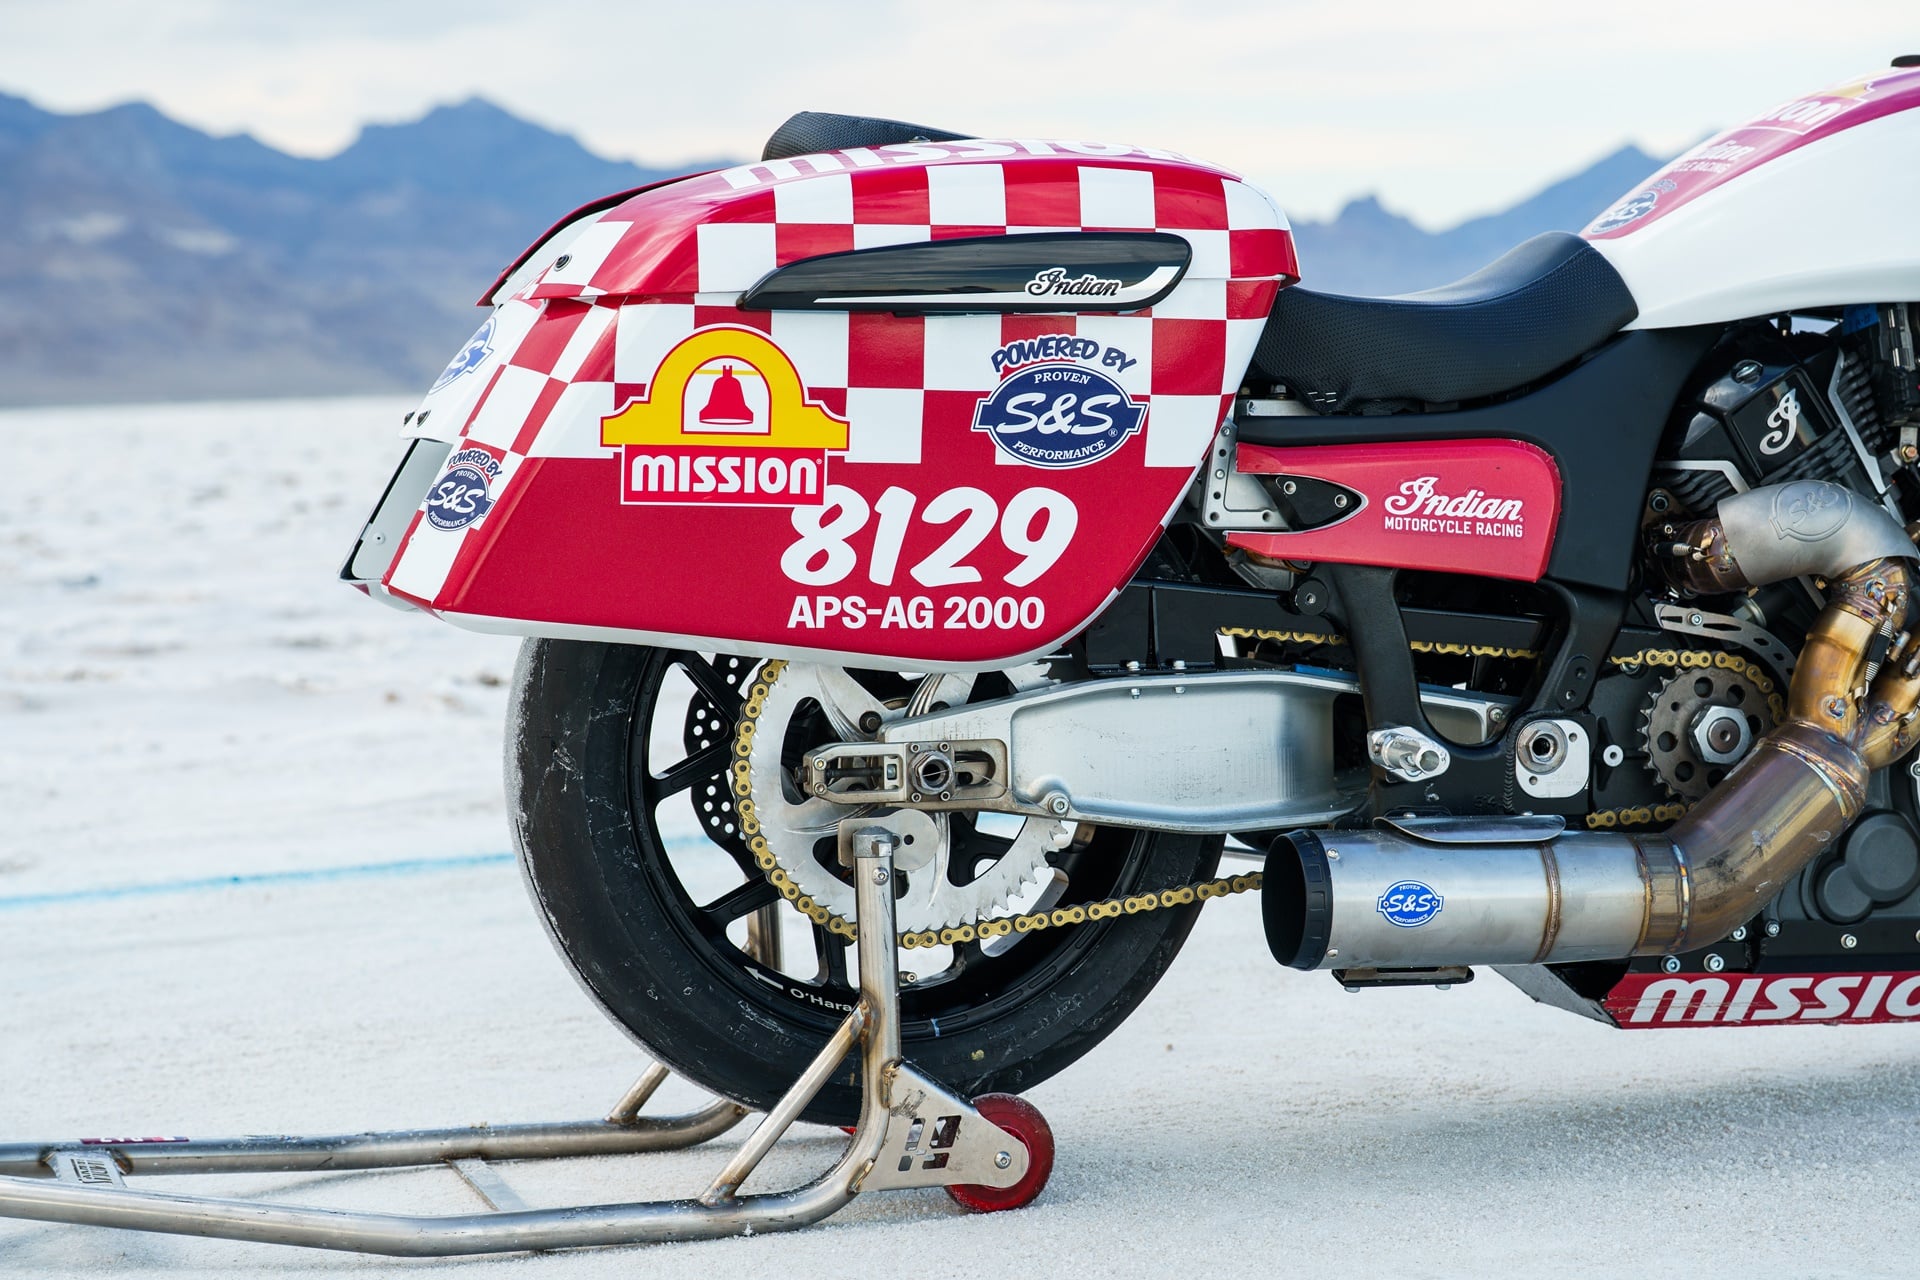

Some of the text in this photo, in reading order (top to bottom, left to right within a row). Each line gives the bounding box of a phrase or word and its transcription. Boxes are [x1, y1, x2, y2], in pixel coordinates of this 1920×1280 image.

[1027, 269, 1121, 296] Indian
[991, 336, 1137, 373] POWERED BY
[1034, 371, 1091, 385] PROVEN
[1012, 439, 1107, 460] PERFORMANCE
[447, 449, 503, 477] POWERED BY
[455, 470, 479, 481] PROVEN
[1384, 476, 1524, 521] Indian
[780, 485, 1079, 588] 8129
[1384, 516, 1523, 538] MOTORCYCLE RACING
[787, 595, 1046, 630] APS-AG 2000
[1386, 894, 1433, 912] S&S
[790, 988, 852, 1012] O'Hara
